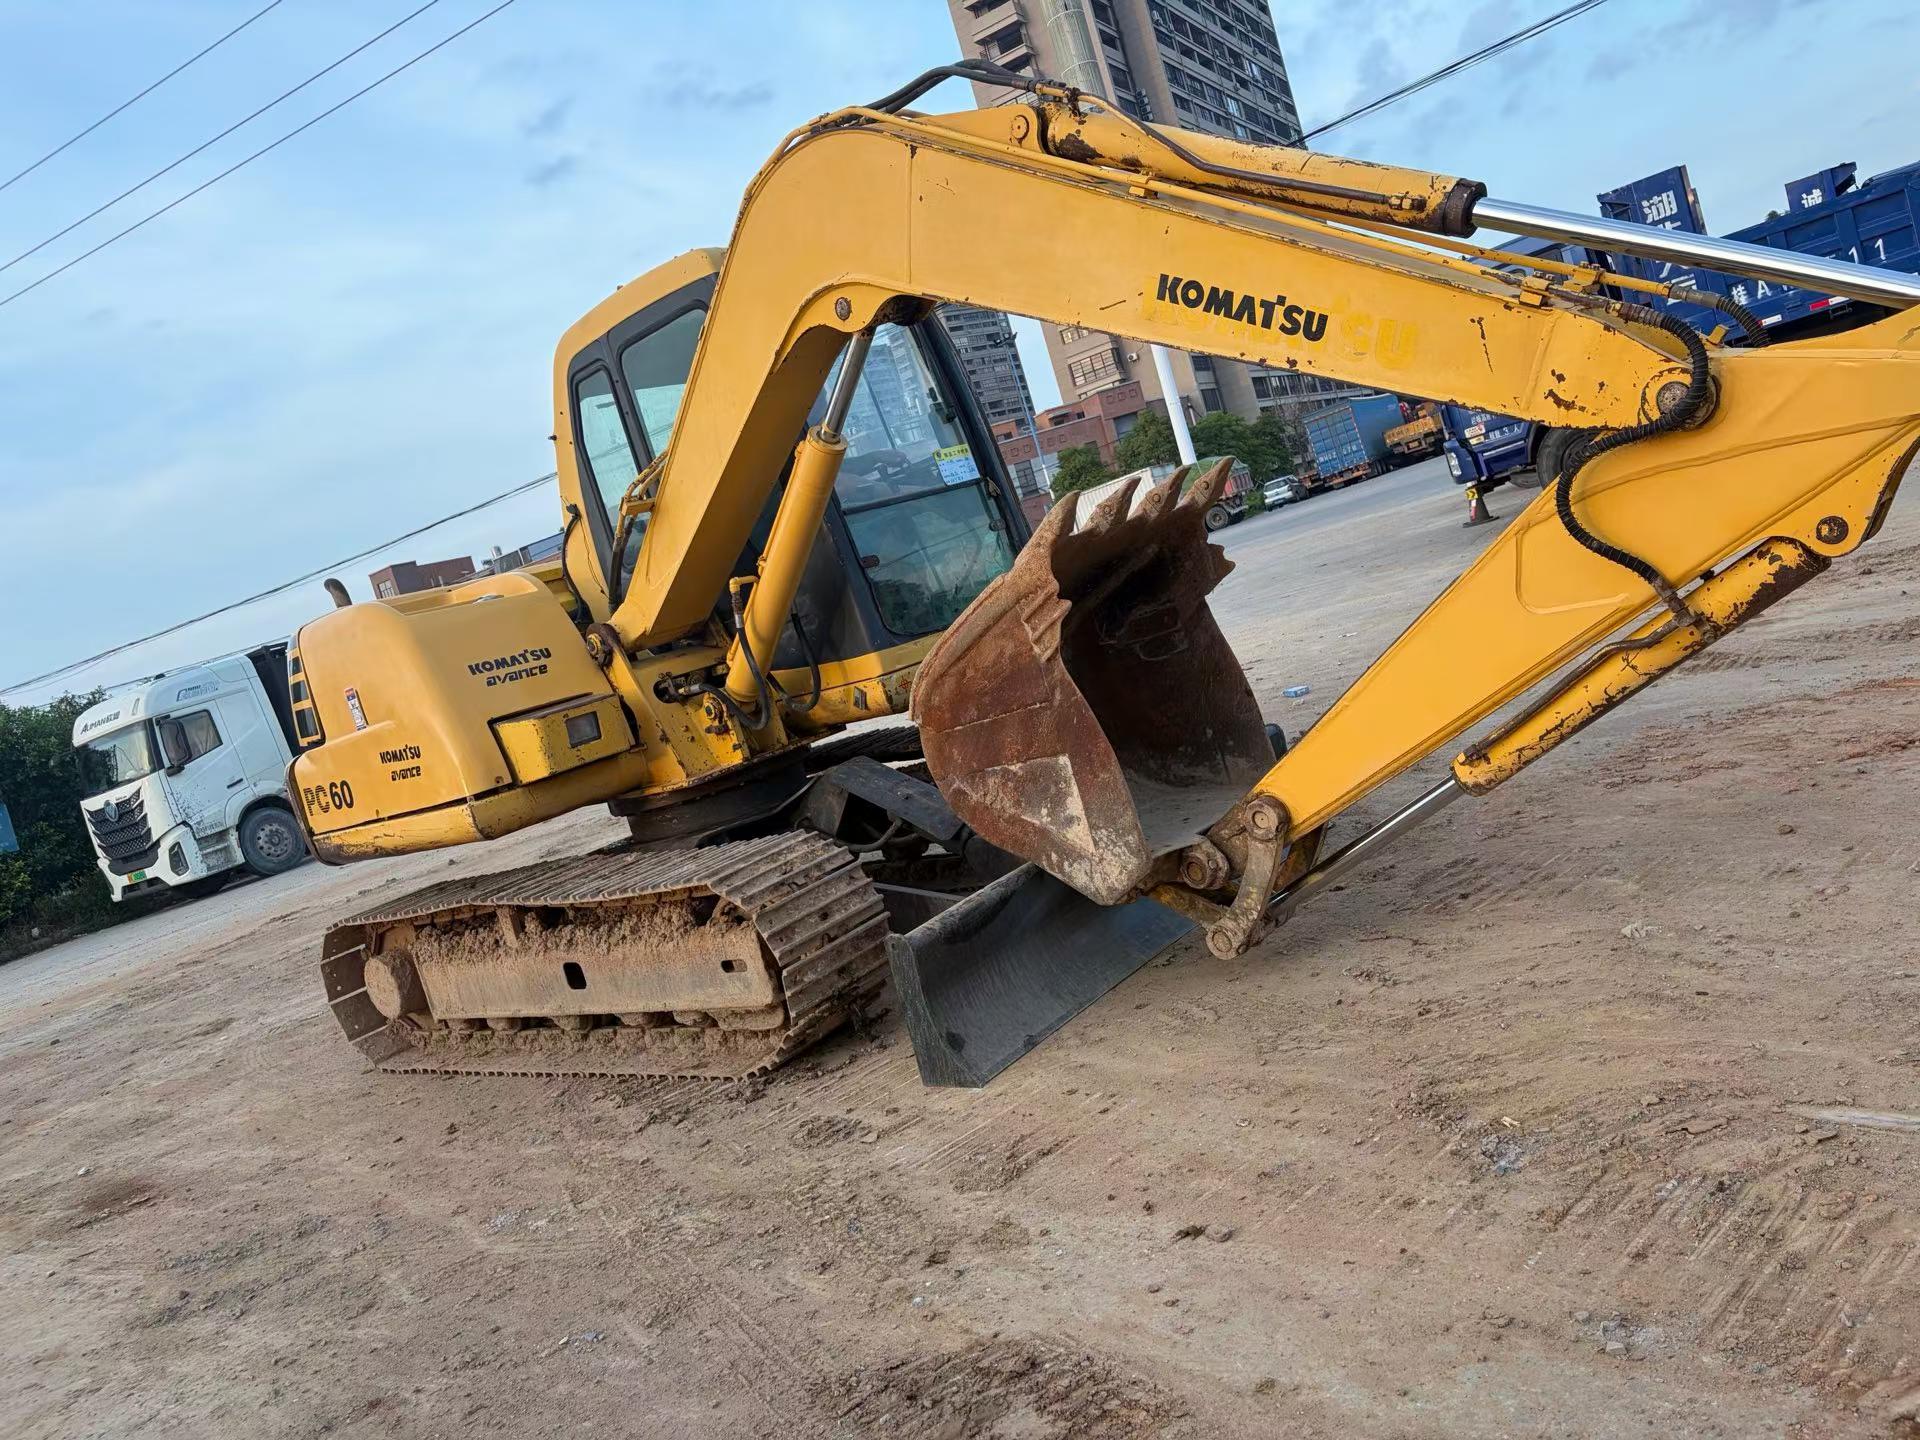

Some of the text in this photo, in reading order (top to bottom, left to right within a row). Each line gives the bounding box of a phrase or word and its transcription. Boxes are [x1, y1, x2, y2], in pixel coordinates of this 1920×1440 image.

[1156, 273, 1329, 342] KOMATSU
[467, 647, 552, 676] KOMATSU
[486, 664, 548, 687] avance
[379, 744, 421, 764] KOMATSU
[391, 765, 421, 781] avance
[303, 780, 354, 817] PC60
